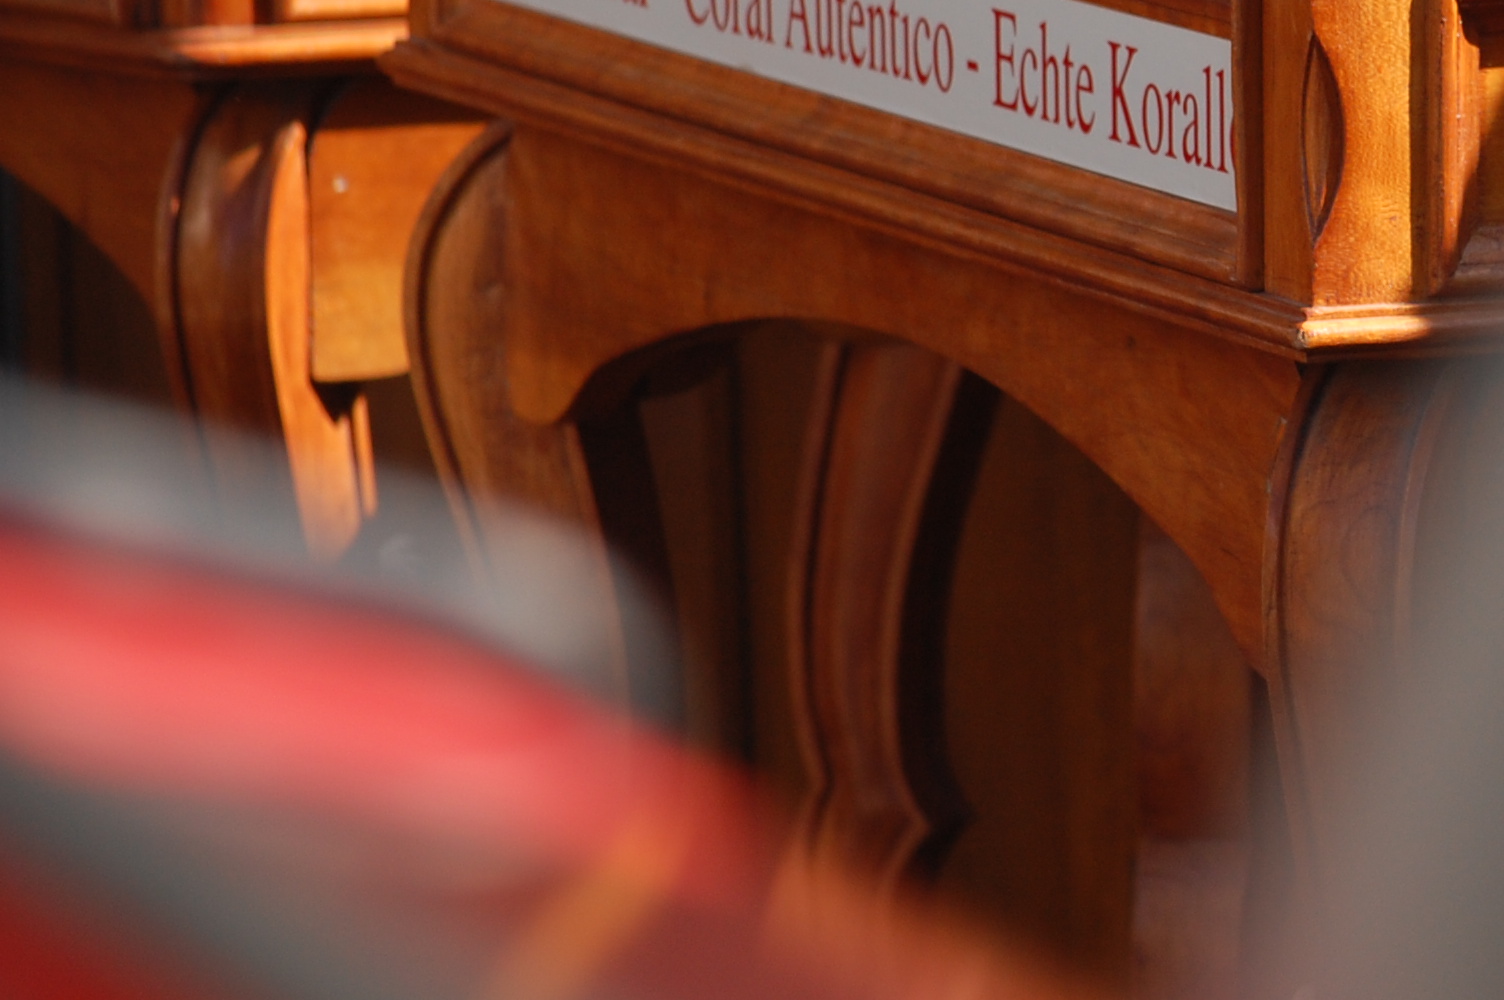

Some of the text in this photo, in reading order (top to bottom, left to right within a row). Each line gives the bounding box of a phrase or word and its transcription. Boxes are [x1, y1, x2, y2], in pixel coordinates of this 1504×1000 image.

[967, 56, 980, 73] -
[992, 7, 1096, 136] Echte
[1107, 40, 1236, 175] Korall
